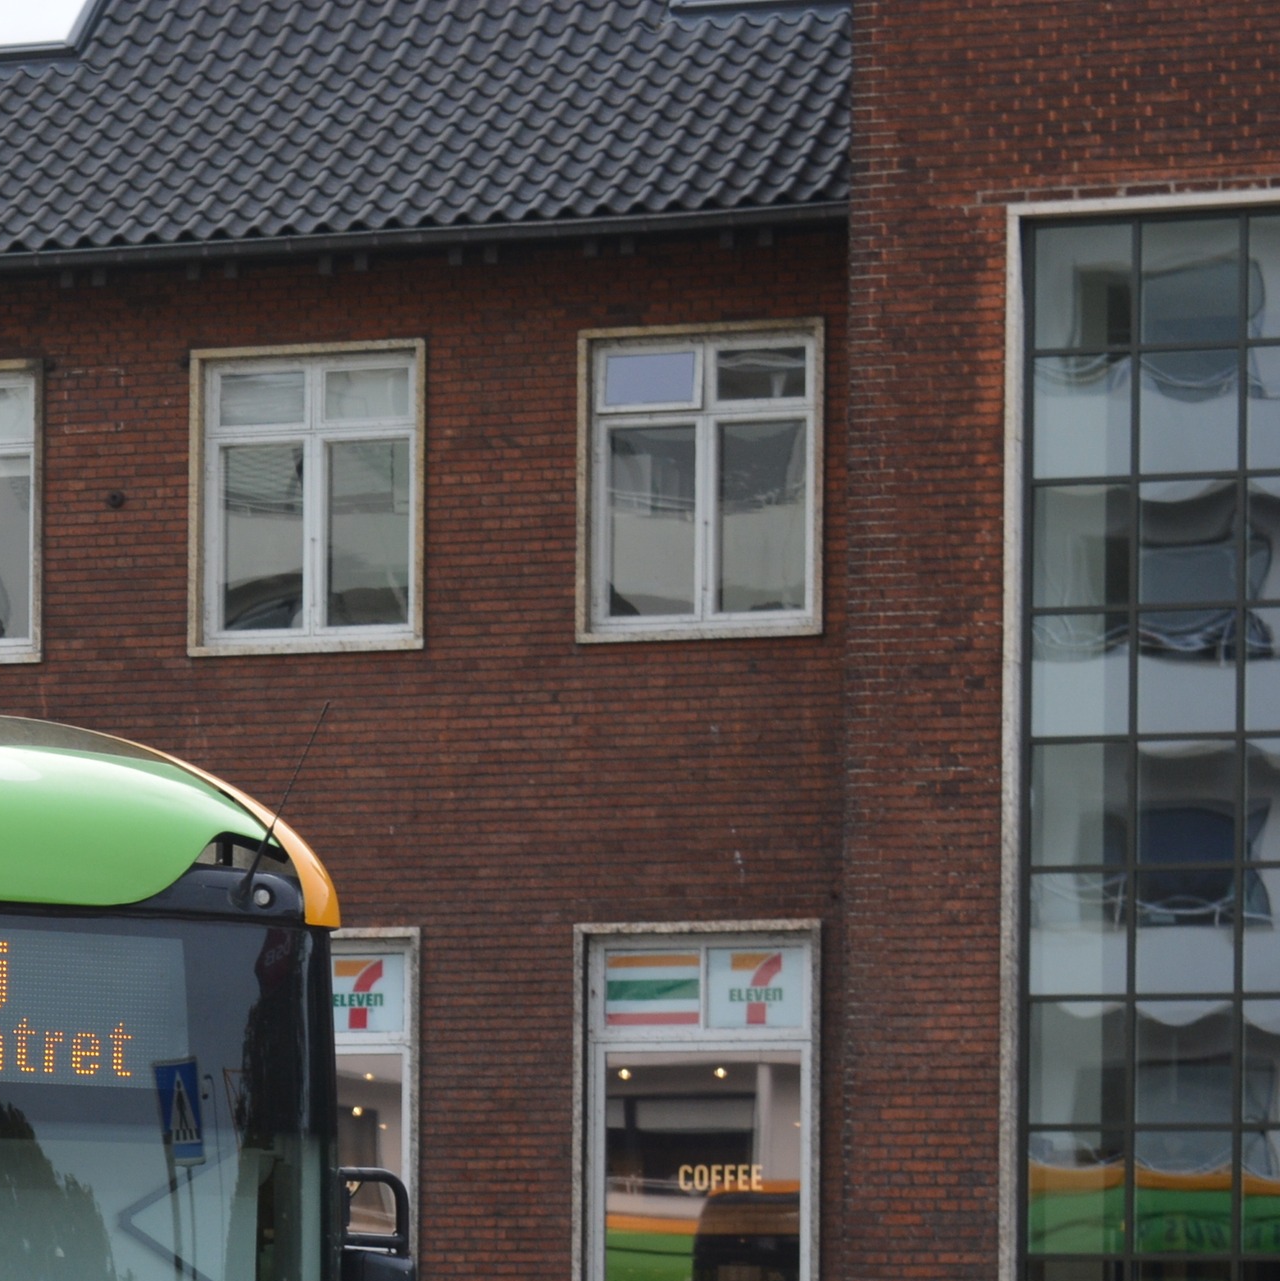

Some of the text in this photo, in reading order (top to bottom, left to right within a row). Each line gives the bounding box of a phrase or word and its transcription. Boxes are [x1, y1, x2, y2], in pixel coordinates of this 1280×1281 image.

[333, 993, 383, 1007] ELEVEN
[729, 987, 783, 1002] ELEVEN
[678, 1164, 764, 1192] COFFEE
